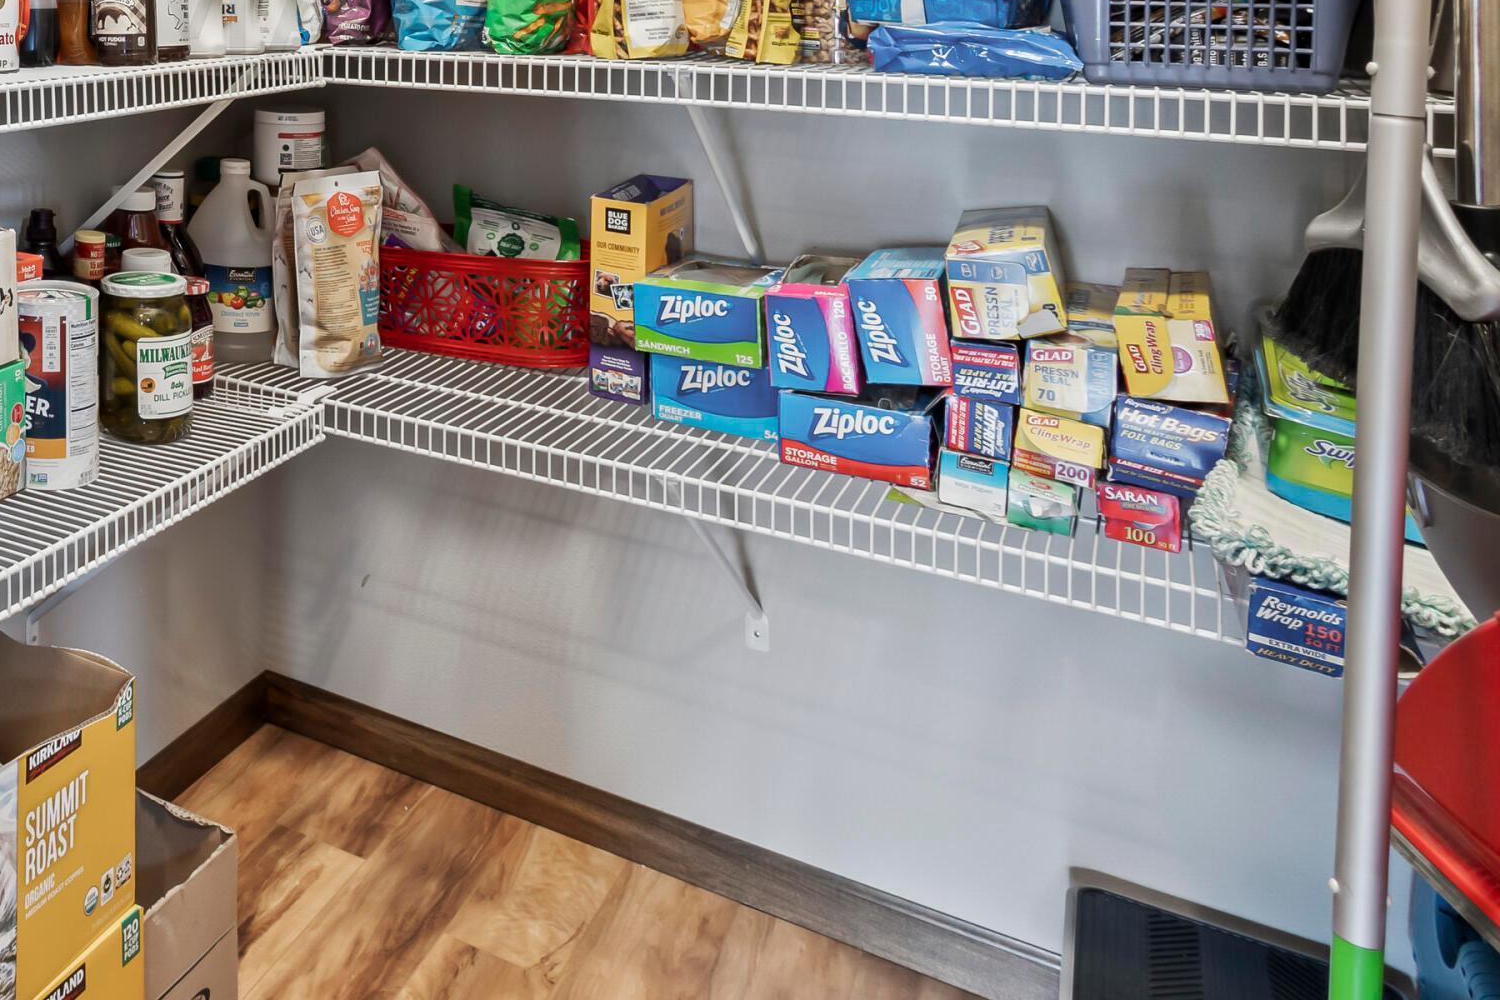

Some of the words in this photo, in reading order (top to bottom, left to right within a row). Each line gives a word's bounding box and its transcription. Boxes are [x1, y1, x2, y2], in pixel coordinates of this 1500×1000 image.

[109, 36, 126, 44] FUDGE
[607, 210, 628, 220] BLUE
[607, 218, 628, 227] DOG
[608, 242, 640, 254] COMMUNITY
[660, 295, 729, 318] Ziploc
[957, 289, 982, 335] GLAD
[860, 299, 890, 365] Ziploc
[139, 339, 192, 363] MILWAUKE
[638, 339, 690, 355] SANDWICH
[771, 312, 800, 376] Ziploc
[736, 354, 754, 365] 125
[835, 331, 854, 391] BOCADILLO
[925, 332, 944, 383] STORAGE
[1032, 350, 1072, 362] GLAD
[680, 366, 751, 393] Ziploc
[154, 392, 171, 402] DILL
[1037, 388, 1055, 401] 70
[659, 405, 702, 419] FREEZER
[813, 407, 894, 440] Ziploc
[1163, 418, 1218, 442] Bags
[1146, 437, 1181, 450] BAGS
[785, 447, 837, 464] STORAGE
[785, 455, 819, 467] GALLON
[1057, 465, 1088, 481] 200
[1104, 487, 1158, 505] SARAN
[1124, 526, 1155, 545] 100
[1255, 606, 1302, 630] Wrap
[1261, 596, 1343, 626] Reynolds
[1305, 623, 1342, 642] 150
[25, 770, 89, 847] SUMMIT
[25, 813, 77, 885] ROAST
[25, 872, 56, 909] ORGANIC
